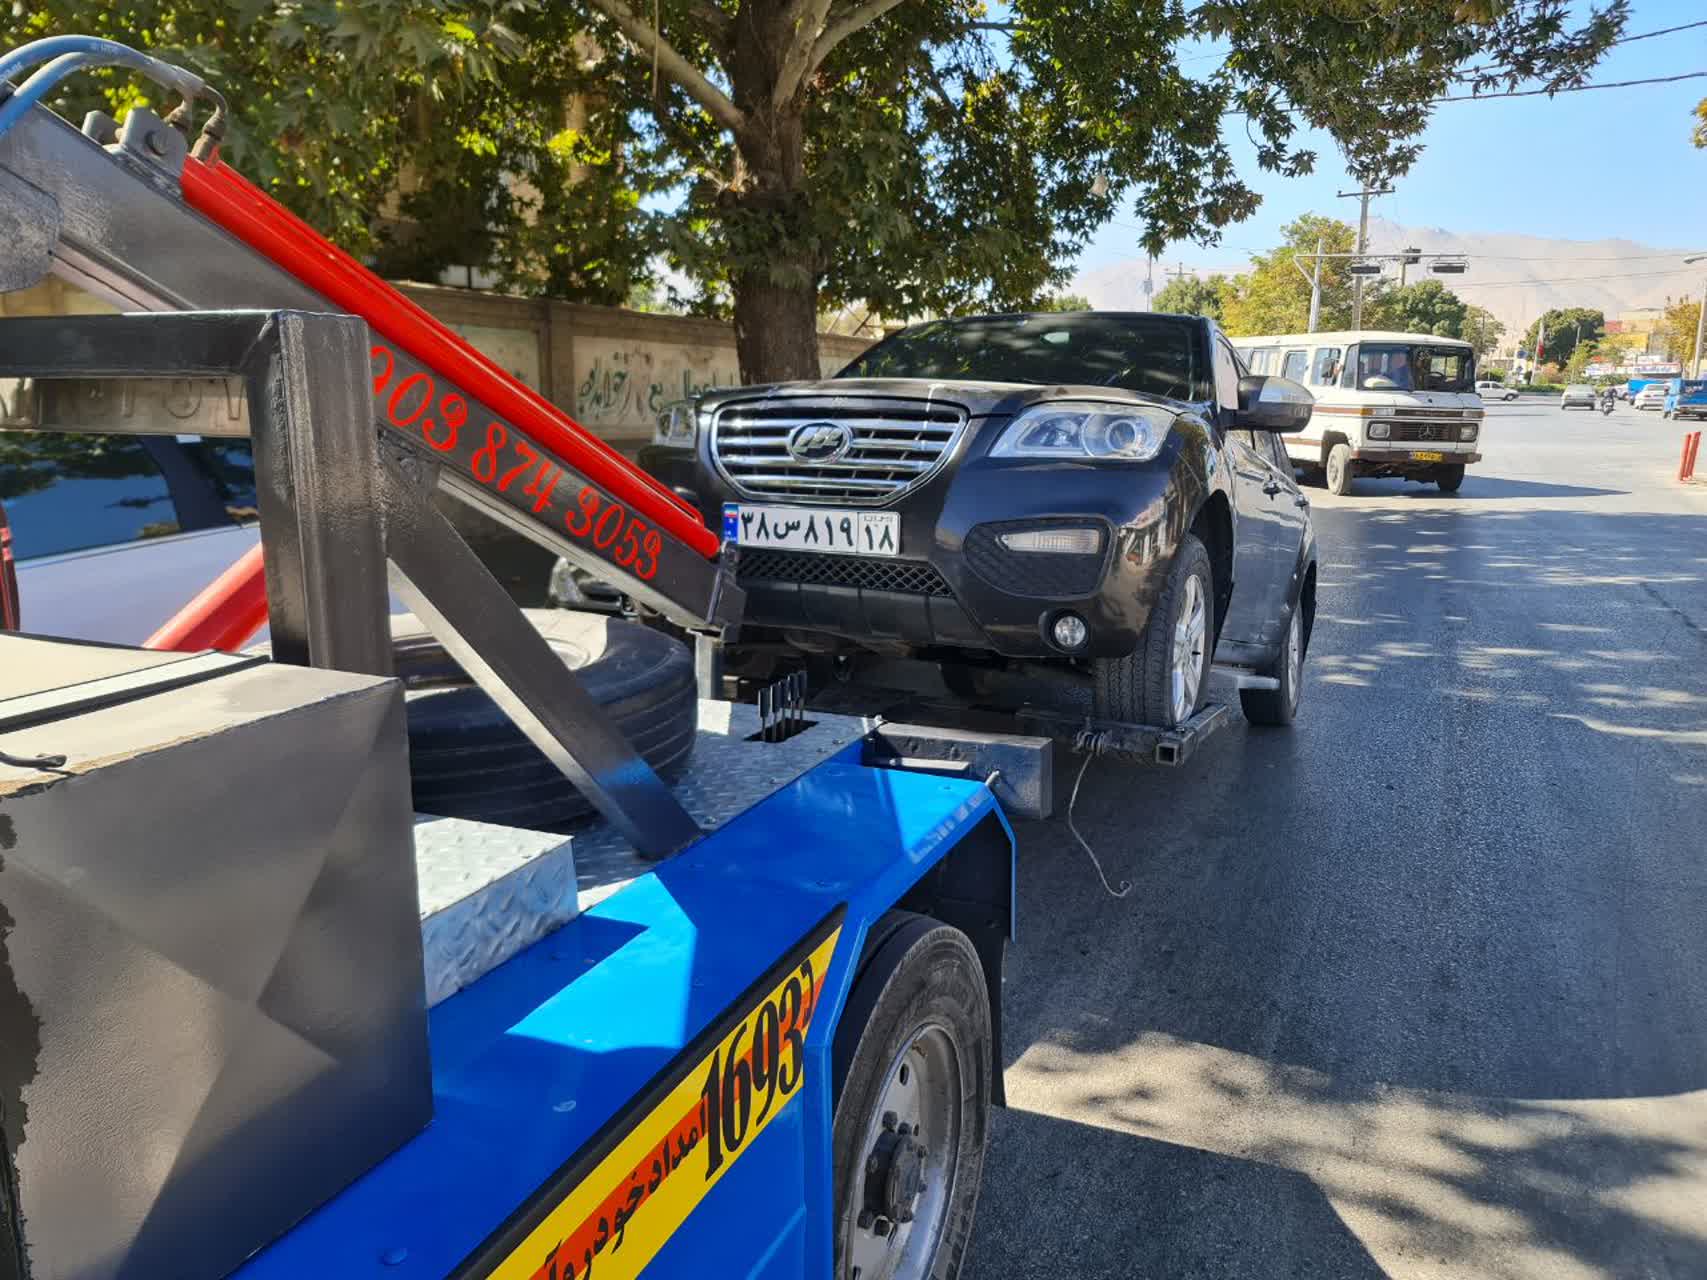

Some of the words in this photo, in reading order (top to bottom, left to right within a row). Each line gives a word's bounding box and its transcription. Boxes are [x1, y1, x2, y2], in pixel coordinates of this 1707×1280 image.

[471, 421, 563, 513] 874
[864, 524, 894, 552] ۱۸
[648, 1104, 707, 1194] امداد
